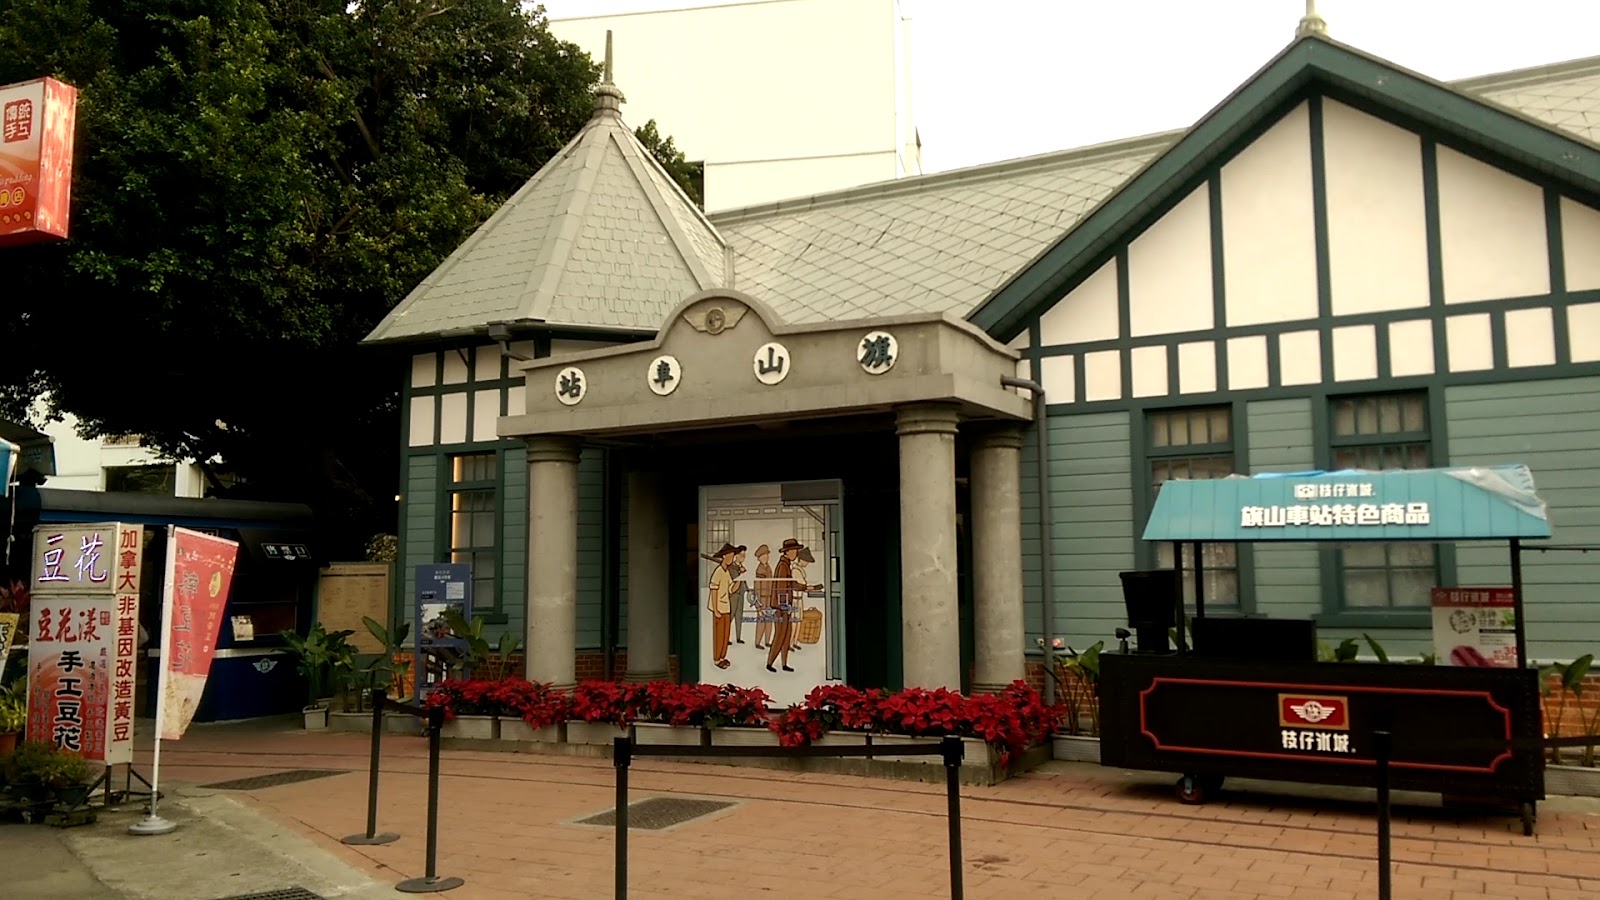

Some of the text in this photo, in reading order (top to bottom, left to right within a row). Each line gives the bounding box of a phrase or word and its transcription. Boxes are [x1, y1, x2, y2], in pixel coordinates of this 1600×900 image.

[5, 121, 30, 139] 手工
[1241, 503, 1430, 526] 旗山車站特色商品
[38, 533, 107, 582] 豆花
[35, 606, 101, 642] 豆花漾
[113, 529, 138, 742] 加拿大非基因改造黃豆
[53, 650, 84, 751] 手工豆花
[1281, 729, 1349, 753] 枝仔冰城
